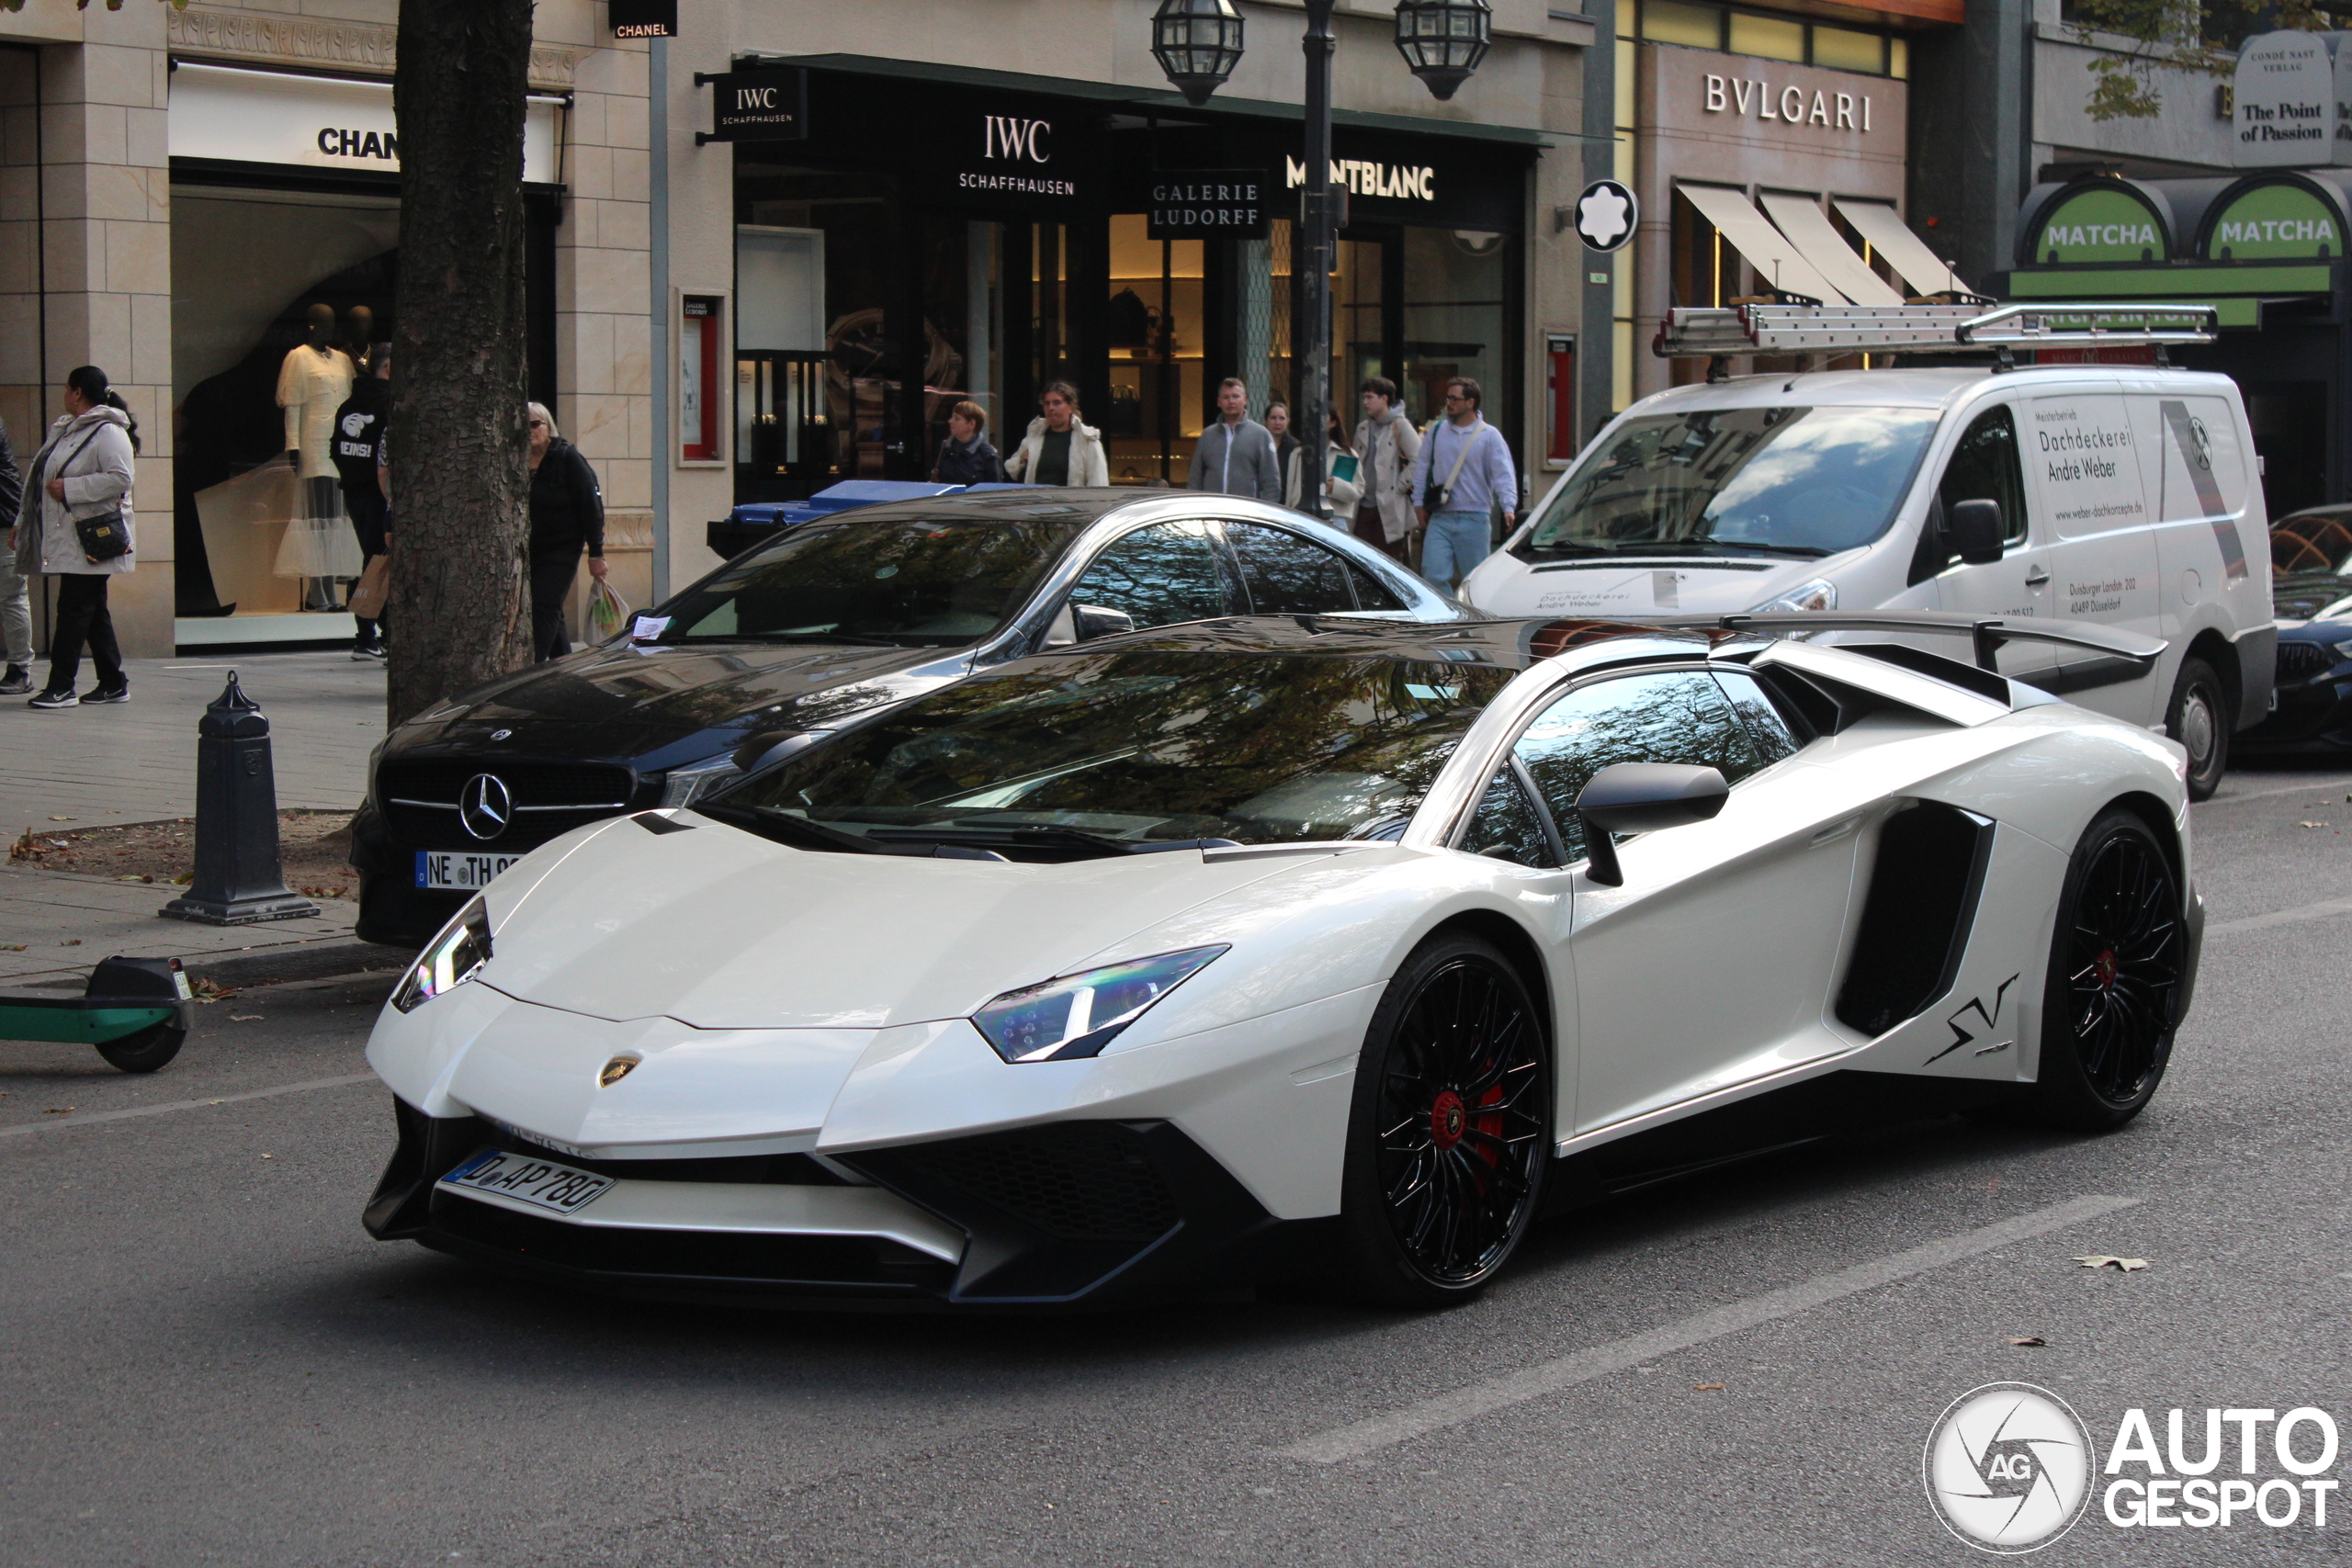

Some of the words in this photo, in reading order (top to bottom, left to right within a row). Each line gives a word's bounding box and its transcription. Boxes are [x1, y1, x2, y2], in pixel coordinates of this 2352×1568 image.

[616, 24, 669, 38] CHANEL
[2290, 49, 2315, 61] NAST
[2263, 62, 2302, 73] VERLAG
[736, 87, 777, 110] IWC
[1704, 73, 1871, 131] BVLGARI
[722, 114, 793, 125] SCHAFFHAUSEN
[2242, 103, 2275, 121] The
[2278, 101, 2322, 119] Point
[317, 127, 401, 160] CHAN
[984, 115, 1051, 164] IWC
[2240, 125, 2259, 143] of
[2261, 123, 2324, 141] Passion
[959, 173, 1075, 196] SCHAFFHAUSEN
[1286, 153, 1435, 202] MNTBLANC
[1153, 185, 1259, 201] GALERIE
[1153, 209, 1259, 226] LUDORFF
[2047, 223, 2156, 246] MATCHA
[2221, 219, 2335, 243] MATCHA
[2039, 425, 2132, 452] Dachdeckerei
[2048, 458, 2081, 482] André
[2082, 456, 2116, 479] Weber
[2069, 582, 2101, 598] Duisburger
[428, 855, 451, 885] NE
[466, 856, 492, 886] TH
[1921, 971, 2020, 1067] SV
[462, 1156, 508, 1180] D
[492, 1162, 552, 1190] AP
